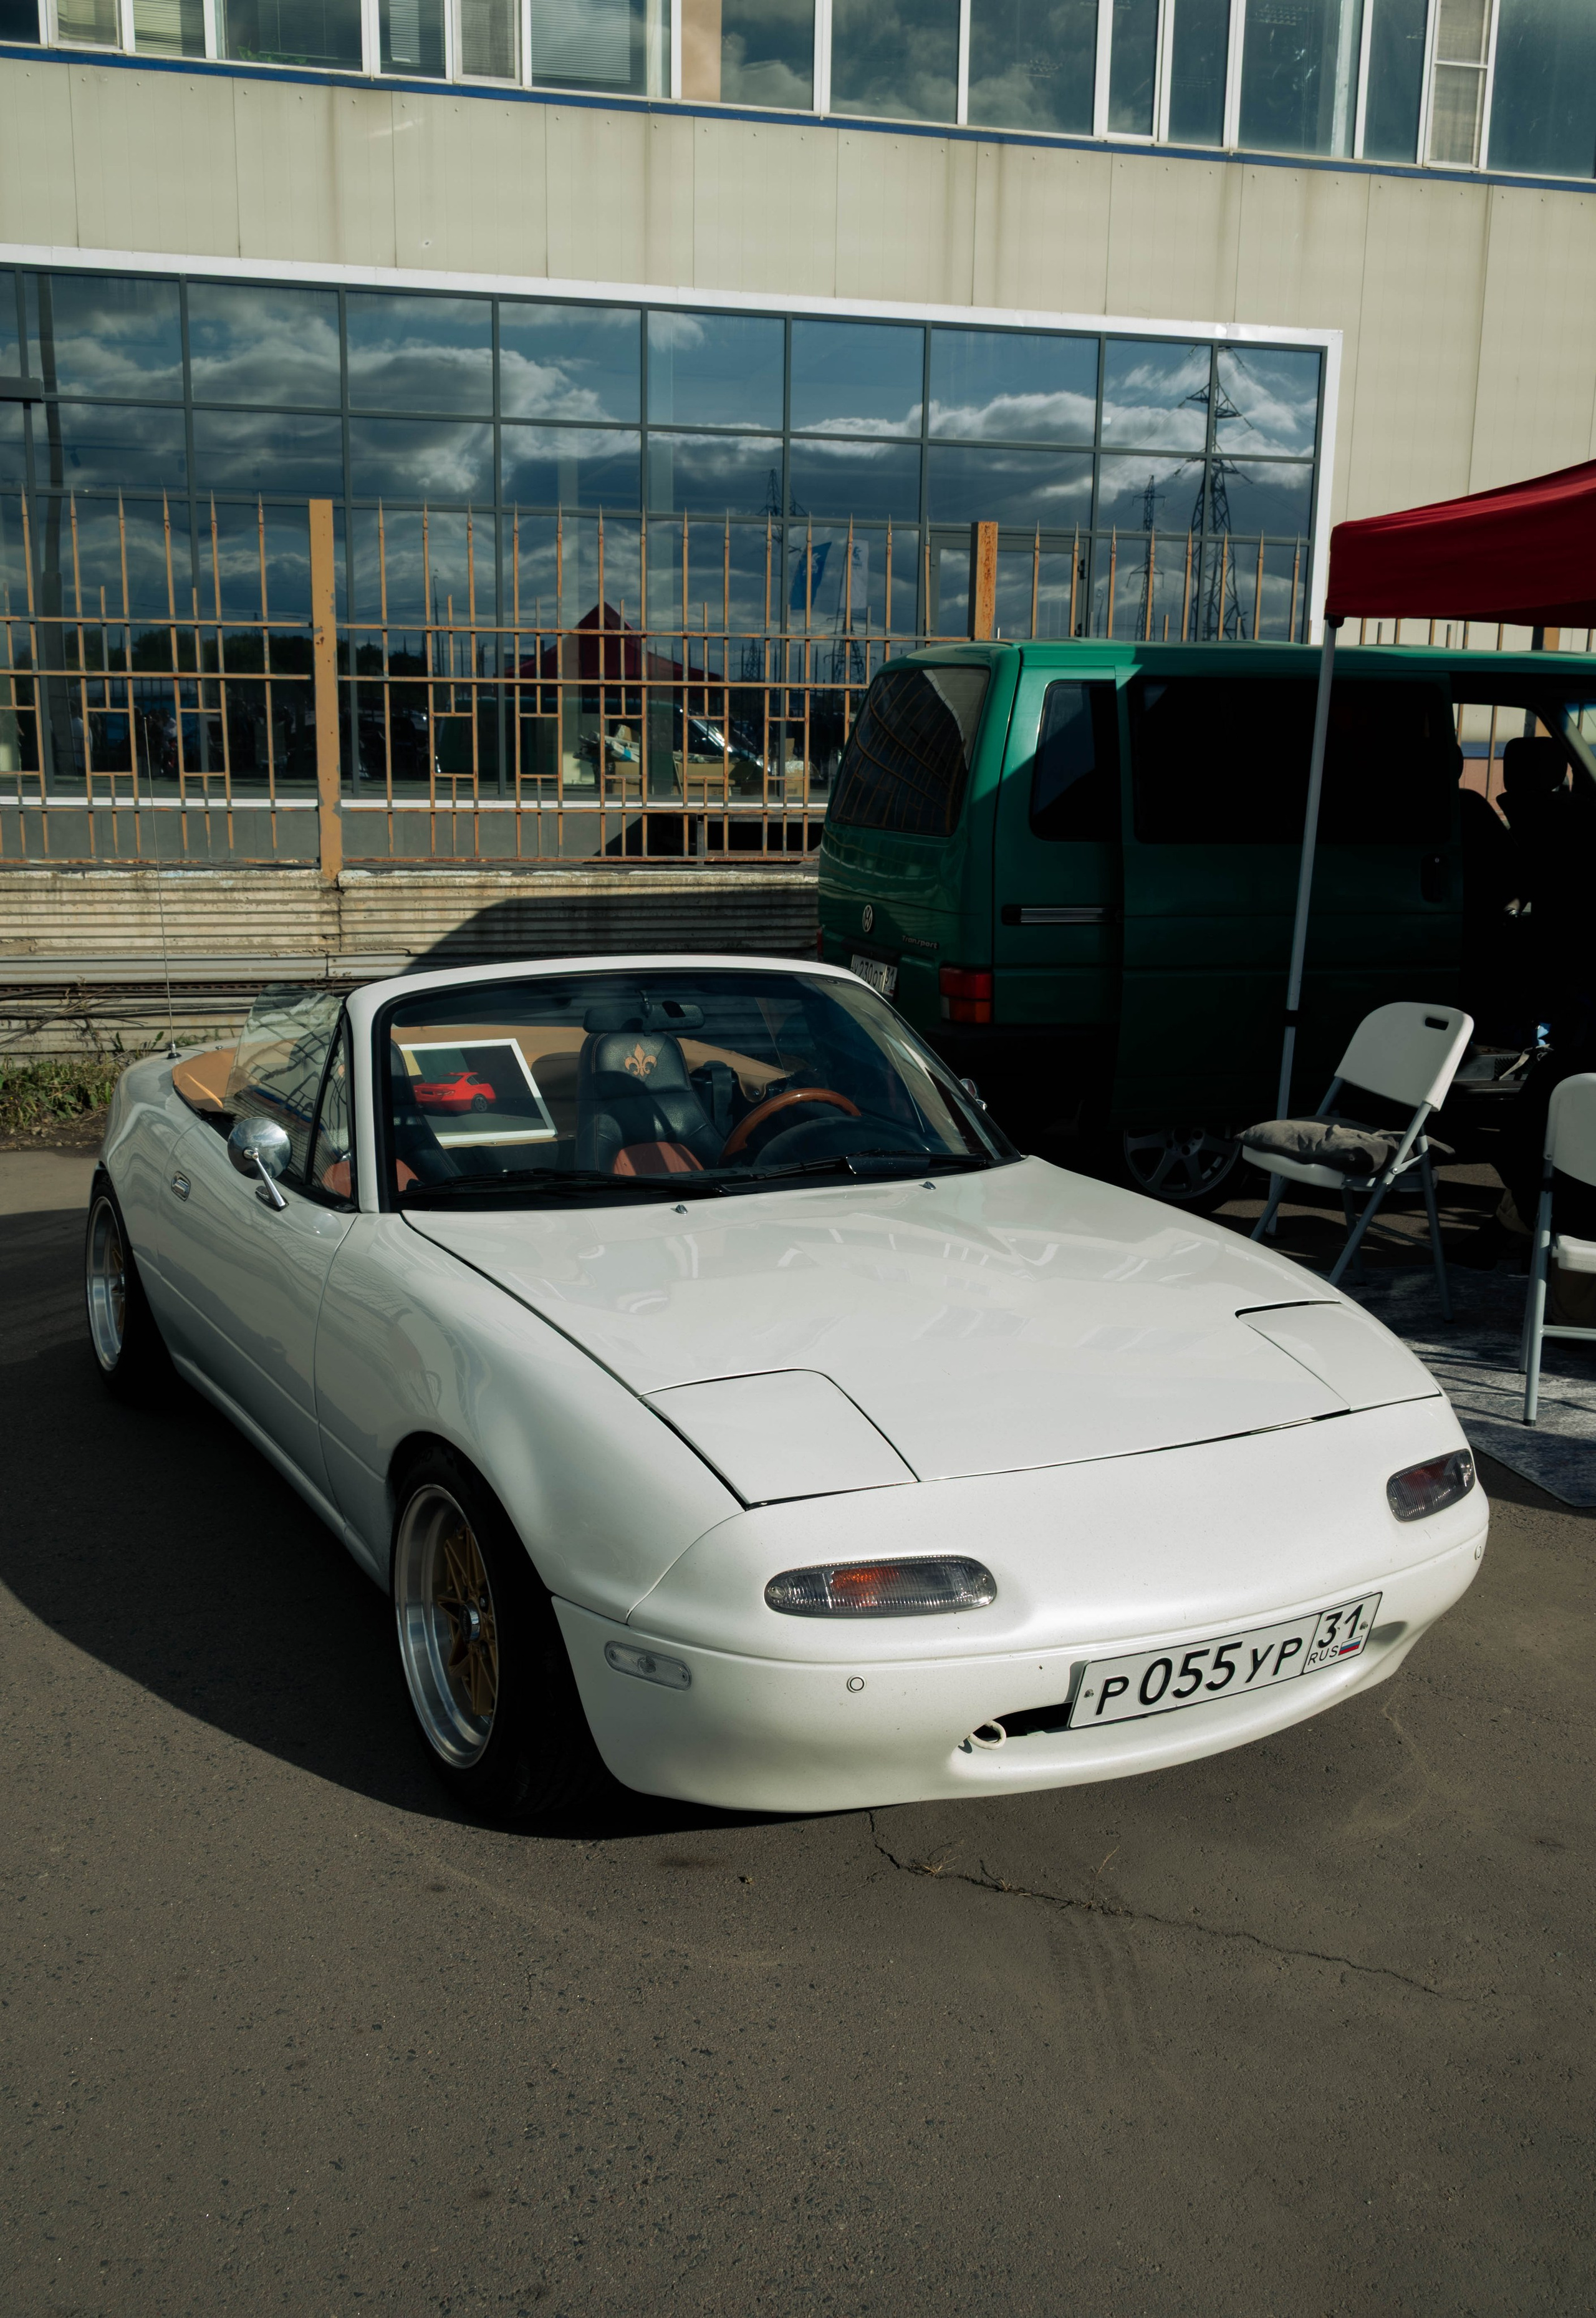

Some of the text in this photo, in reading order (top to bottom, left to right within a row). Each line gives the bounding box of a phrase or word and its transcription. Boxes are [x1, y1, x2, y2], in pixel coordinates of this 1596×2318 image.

[902, 935, 938, 949] Transport
[885, 967, 895, 987] 31
[1318, 1604, 1364, 1648] 31
[1307, 1644, 1339, 1666] RUS
